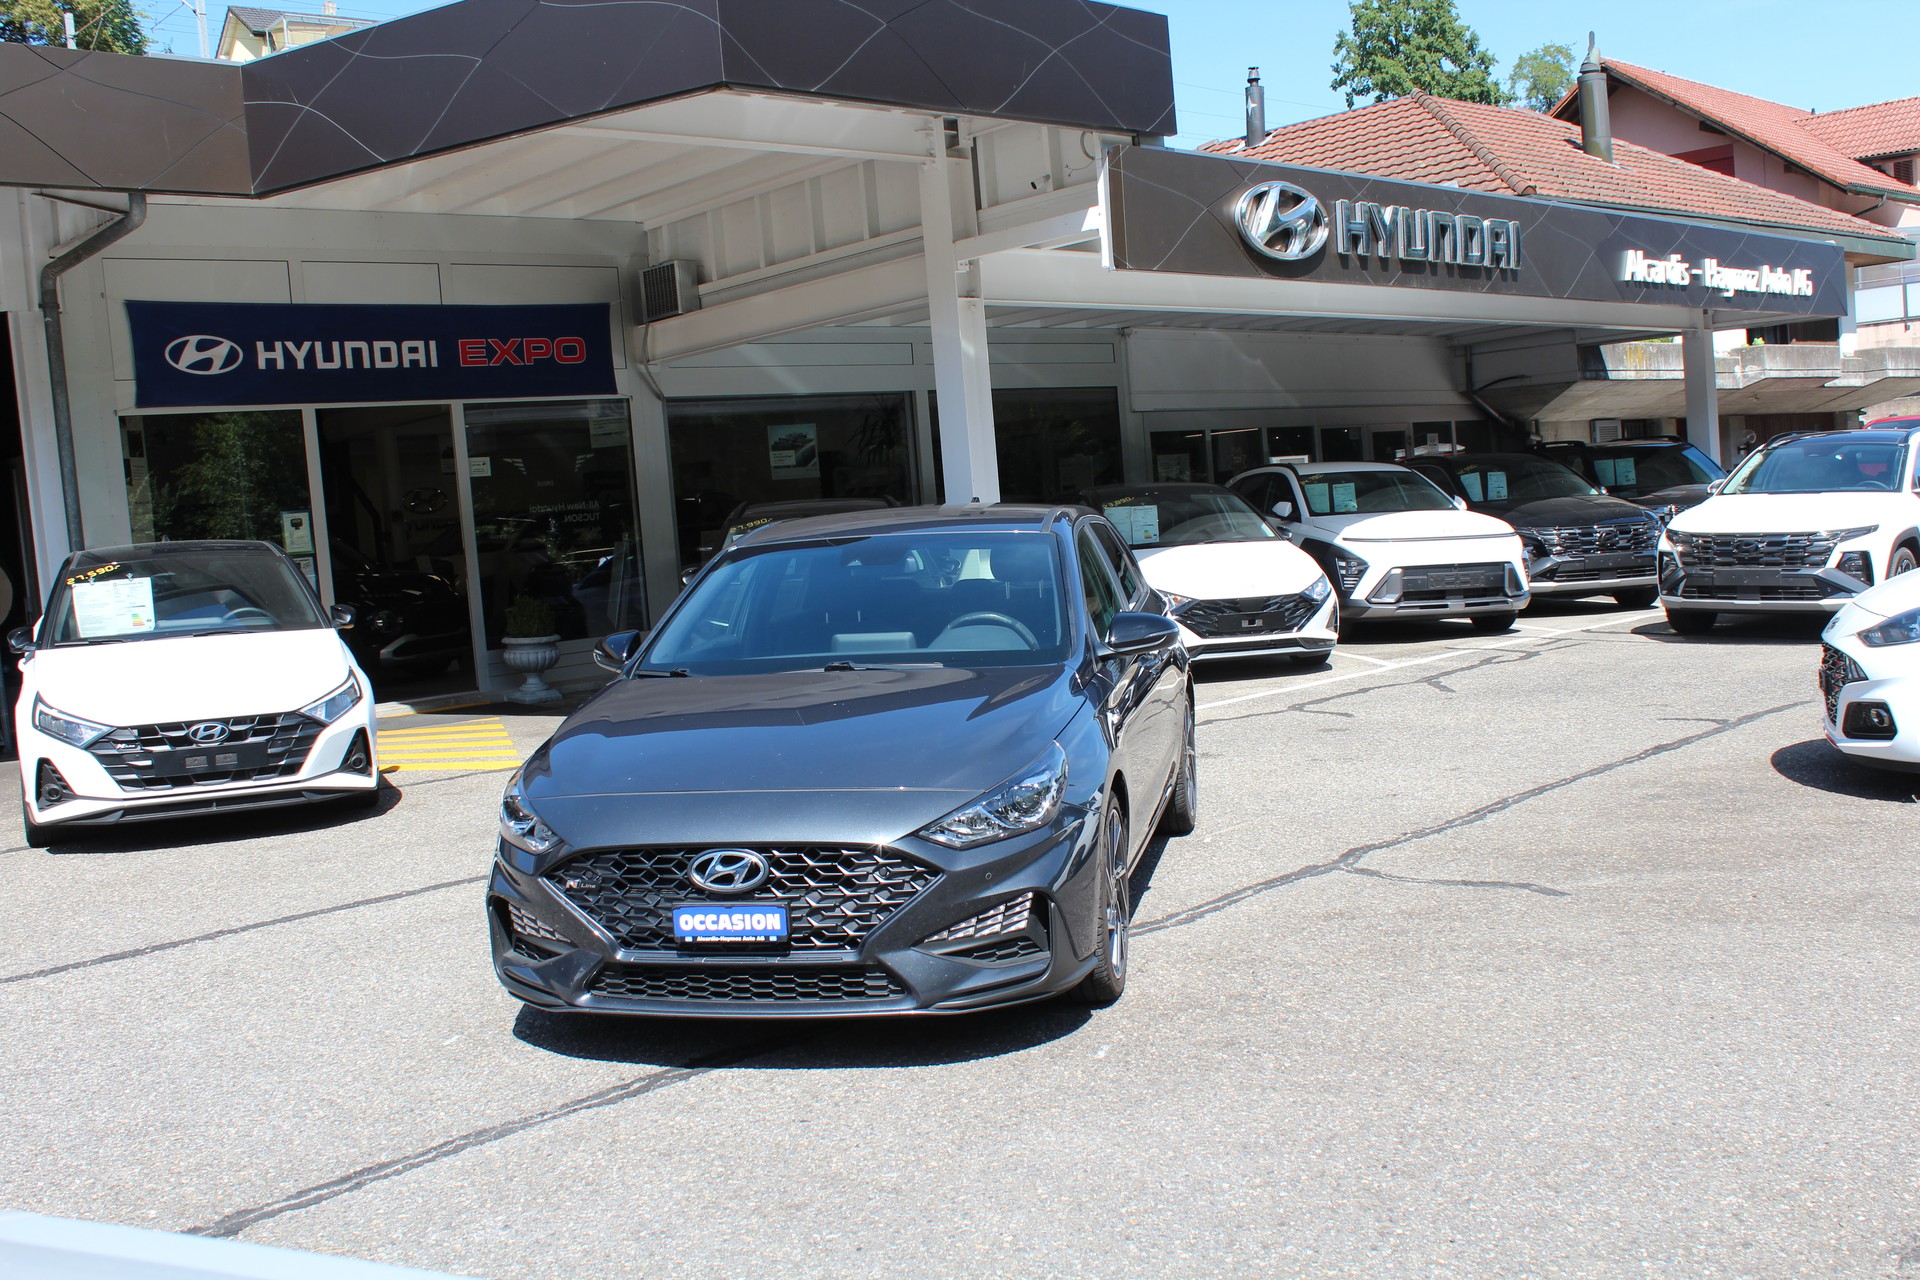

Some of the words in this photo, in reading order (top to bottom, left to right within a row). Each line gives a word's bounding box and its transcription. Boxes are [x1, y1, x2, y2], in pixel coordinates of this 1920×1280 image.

[1335, 199, 1522, 270] HYUNDAI
[256, 340, 439, 370] HYUNDAI
[458, 336, 586, 367] EXPO
[679, 913, 781, 931] OCCASION
